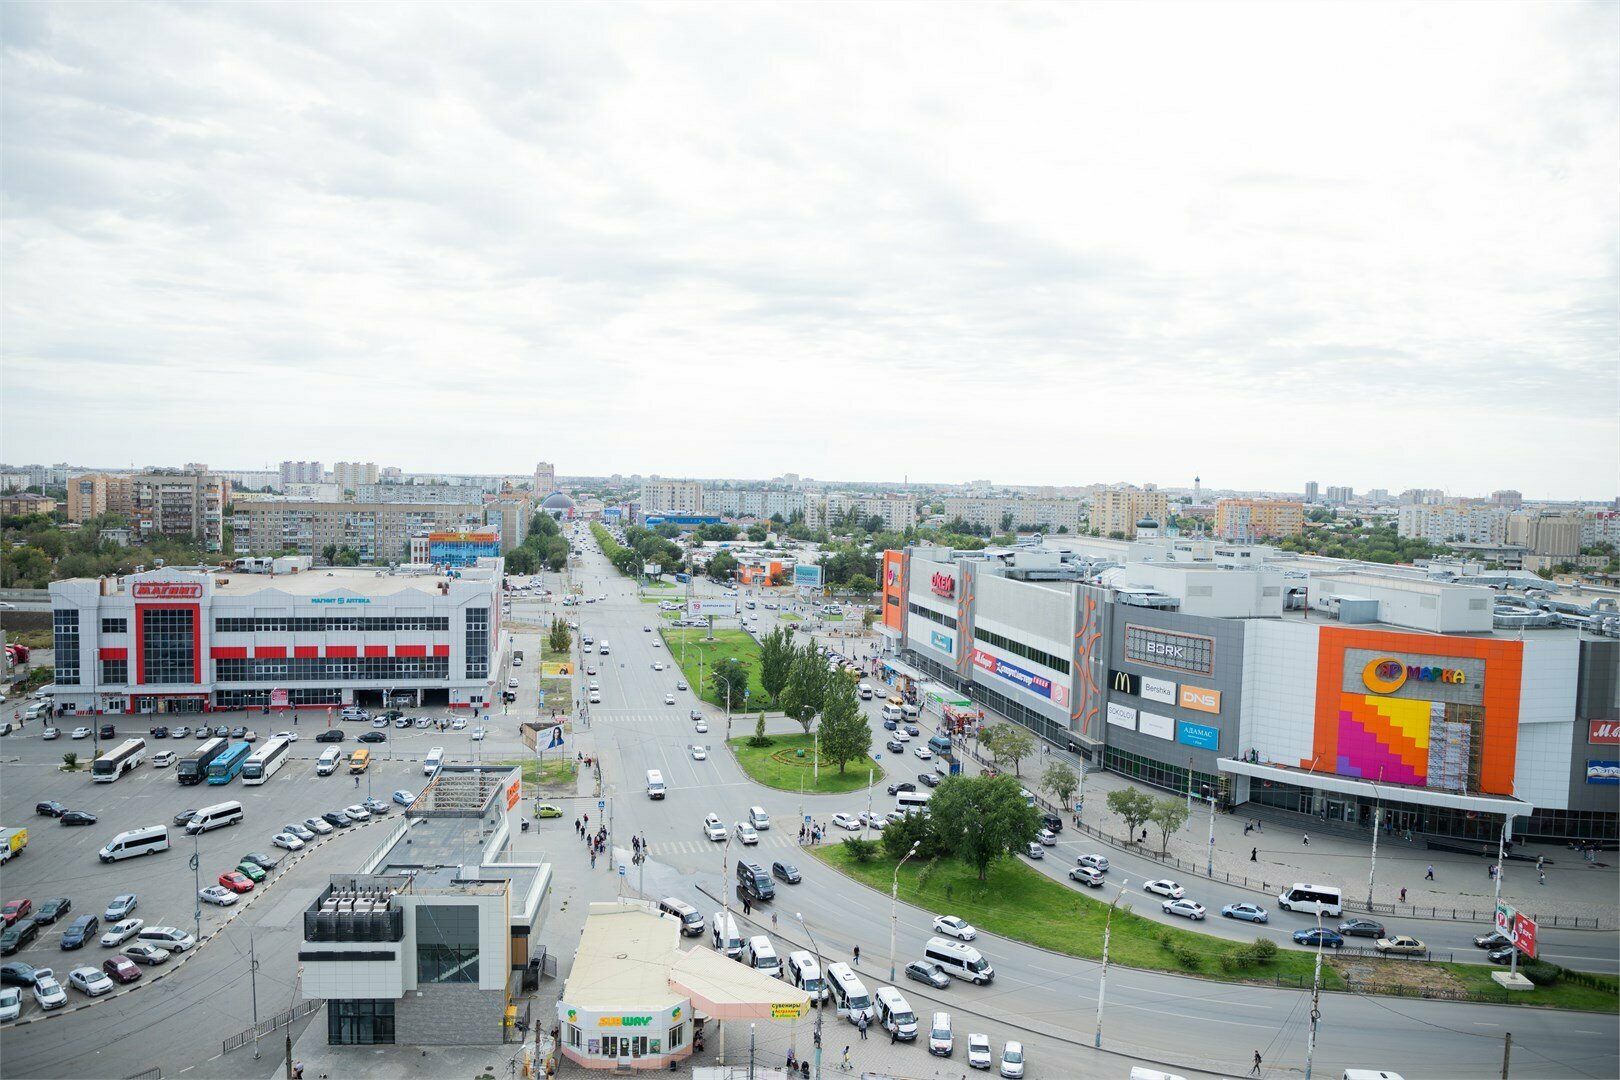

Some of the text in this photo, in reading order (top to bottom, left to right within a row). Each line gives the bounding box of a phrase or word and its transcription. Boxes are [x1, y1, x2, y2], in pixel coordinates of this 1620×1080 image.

[137, 586, 198, 595] МАГНИТ
[1147, 641, 1183, 658] BORK
[1145, 683, 1171, 696] Bershka
[1183, 691, 1216, 707] DNS
[1108, 706, 1135, 720] SOKOLOV
[1183, 726, 1213, 738] АДАМАС
[598, 1016, 652, 1027] SUBWAY
